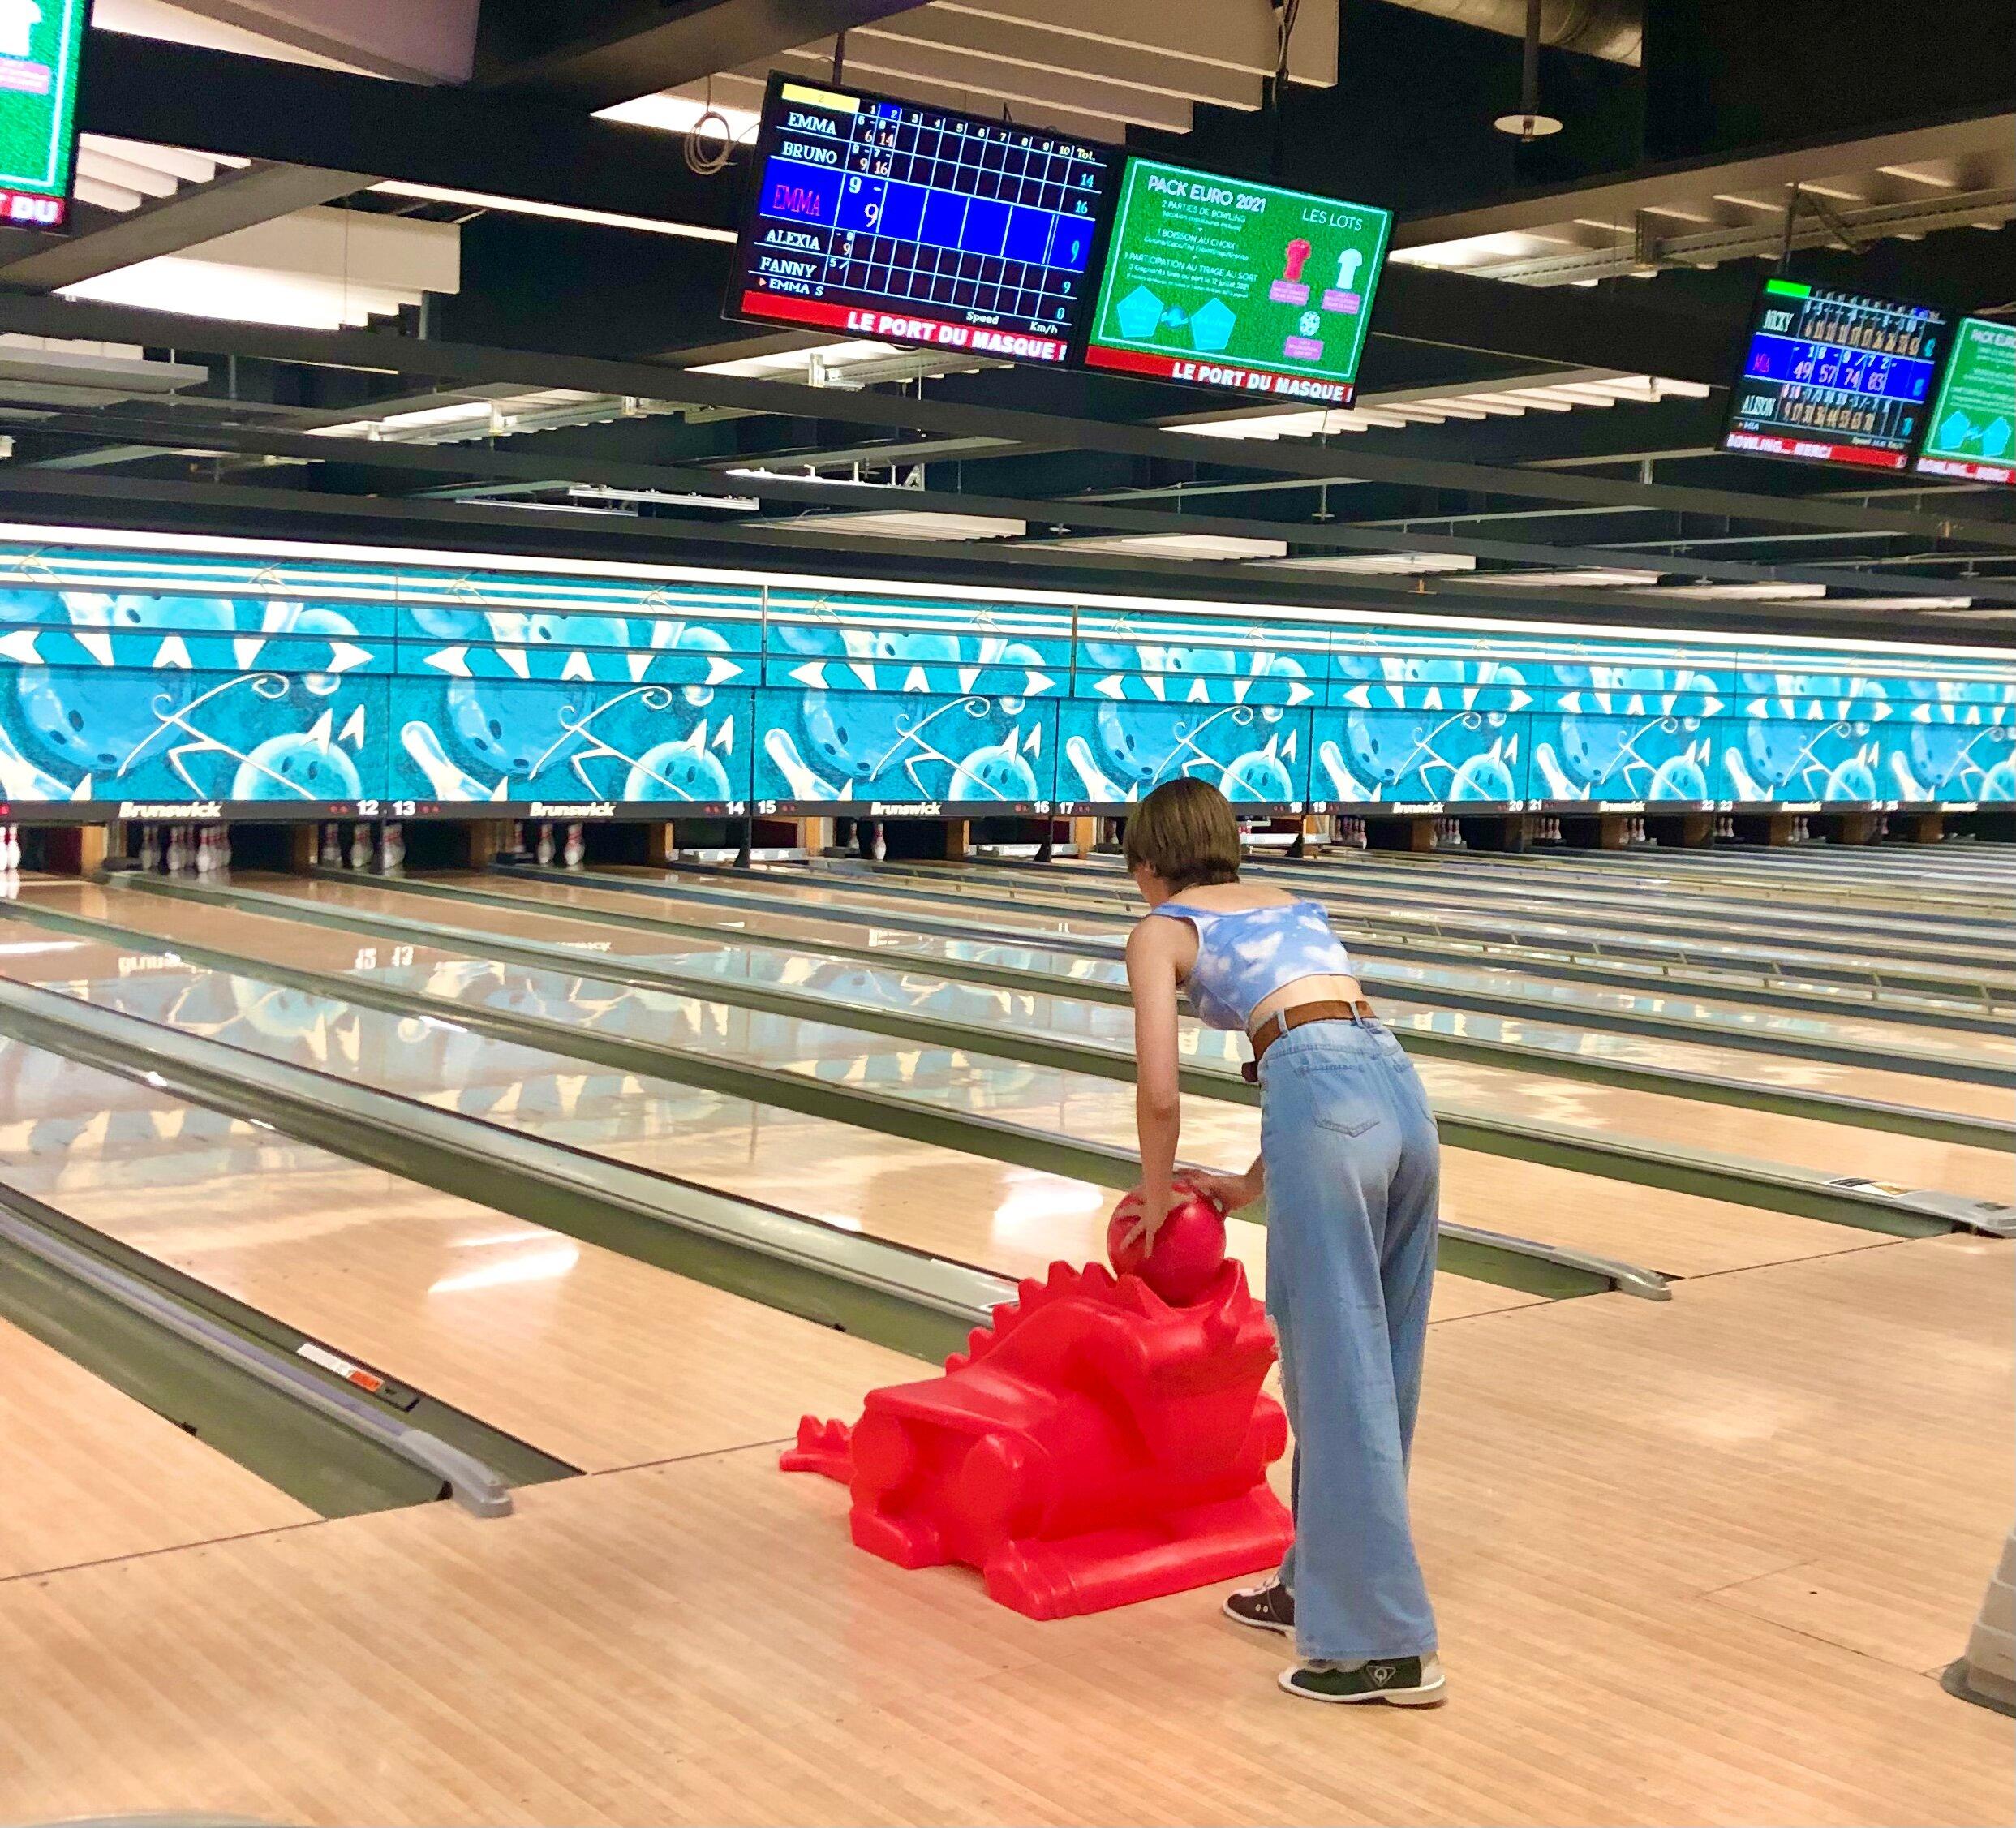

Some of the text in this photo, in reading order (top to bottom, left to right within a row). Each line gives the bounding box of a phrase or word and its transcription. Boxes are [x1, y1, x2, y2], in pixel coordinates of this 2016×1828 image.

[787, 111, 837, 135] EMMA
[864, 130, 894, 148] 6 14
[956, 123, 964, 133] 5
[978, 127, 986, 138] 6
[999, 132, 1008, 142] 7
[1059, 145, 1071, 156] 10
[781, 141, 838, 165] BRUNO
[860, 158, 888, 176] 9 16
[849, 176, 862, 194] 9
[1080, 173, 1094, 187] 14
[772, 184, 821, 217] EMMA
[1147, 174, 1266, 213] PACK EURO 2021
[1075, 200, 1088, 214] 16
[864, 203, 879, 228] 9
[1302, 208, 1362, 231] LES LOTS
[765, 229, 821, 251] ALEXIA
[1162, 229, 1197, 243] BOISSON
[1197, 235, 1210, 244] AU
[1210, 239, 1236, 250] CHOIX
[843, 243, 851, 256] 9
[1070, 240, 1080, 263] 9
[759, 256, 818, 278] FANNY
[1129, 252, 1184, 269] PARTICIPATION
[1186, 263, 1197, 272] AU
[1199, 265, 1225, 277] TIRAGE
[1226, 270, 1237, 279] AU
[1238, 272, 1258, 282] SORT
[769, 278, 824, 296] EMMA S
[1063, 281, 1071, 294] 9
[966, 311, 999, 325] Speed
[1056, 308, 1065, 319] 0
[846, 311, 876, 332] LE
[878, 315, 936, 340] PORT
[938, 326, 969, 346] DU
[971, 330, 1056, 360] MASQUE
[1029, 321, 1058, 334] Km/h
[1171, 362, 1197, 380] LE
[1197, 365, 1245, 386] PORT
[1246, 373, 1271, 390] DU
[1275, 377, 1345, 401] MASQUE
[1793, 361, 1812, 380] 49
[1819, 364, 1837, 384] 57
[1844, 368, 1861, 388] 74
[118, 801, 221, 818] Brunswick
[356, 800, 379, 815] 12
[392, 800, 415, 816] 13
[530, 801, 615, 817] Brunswick
[726, 801, 744, 815] 14
[758, 800, 776, 815] 15
[870, 802, 941, 815] Brunswick
[1034, 801, 1050, 814] 16
[1059, 802, 1073, 815] 17
[1313, 801, 1326, 813] 19
[1392, 801, 1444, 814] Brunswick
[1508, 800, 1523, 811] 20
[1529, 799, 1542, 811] 21
[1702, 800, 1714, 811] 22
[1720, 800, 1733, 811] 23
